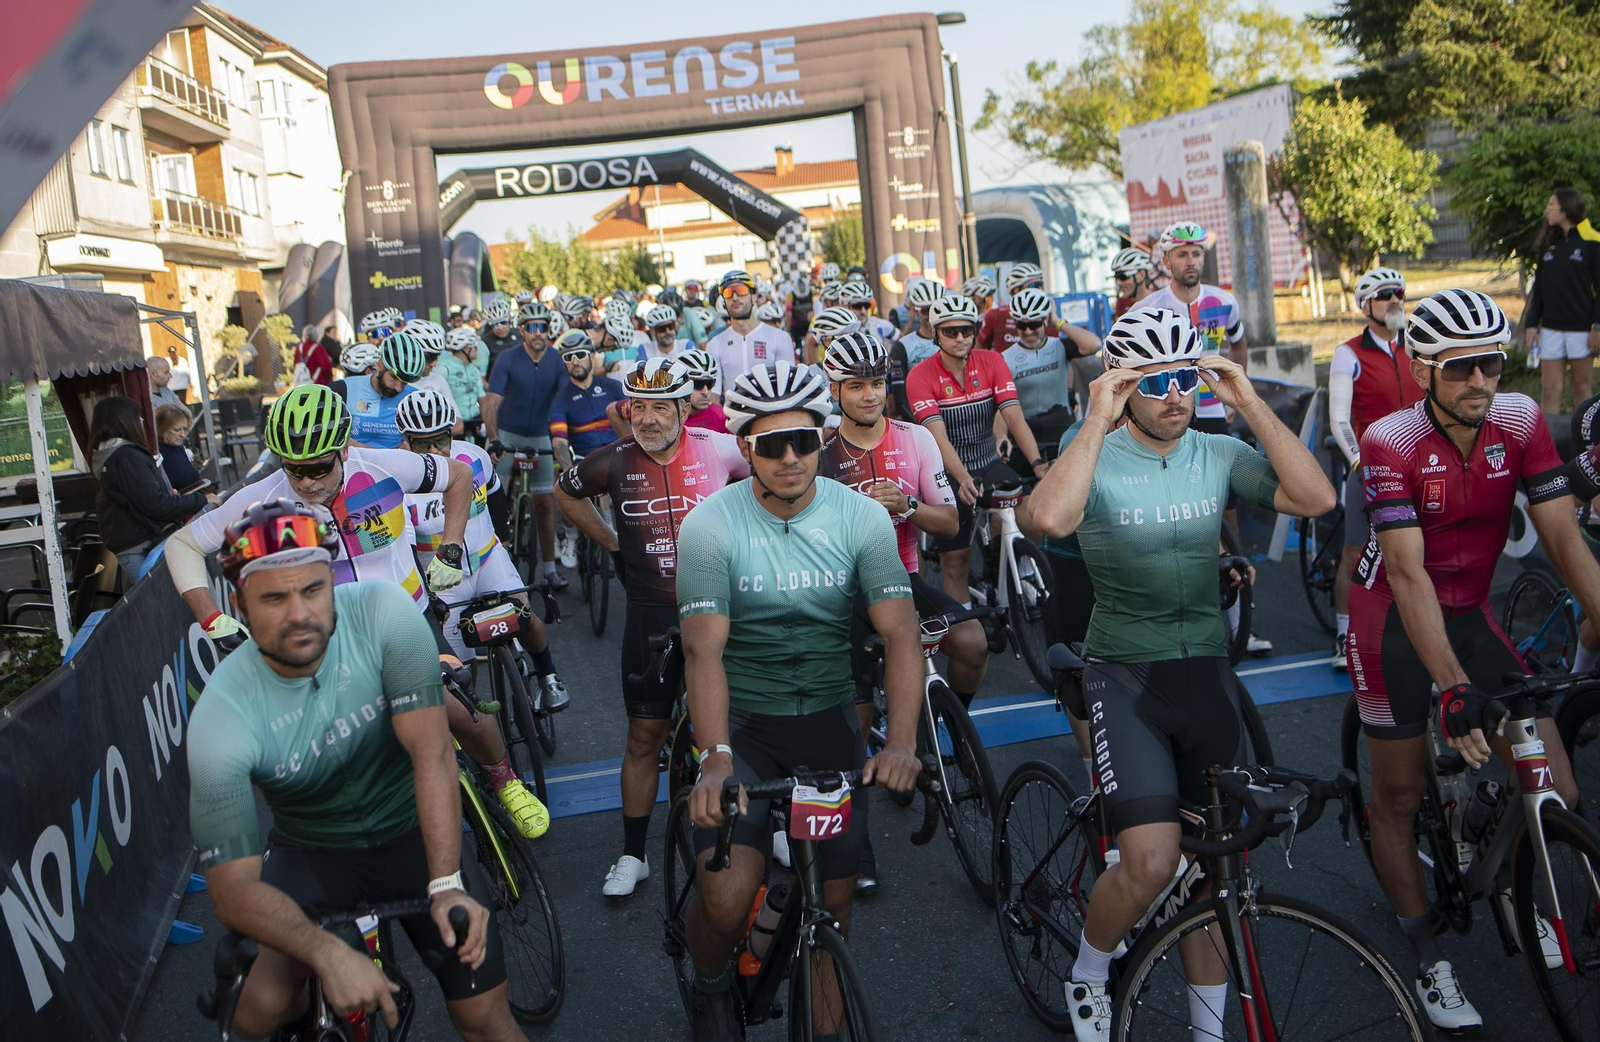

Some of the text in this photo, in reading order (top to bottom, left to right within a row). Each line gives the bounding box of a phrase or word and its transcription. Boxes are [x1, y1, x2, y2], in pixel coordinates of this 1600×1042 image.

[483, 36, 801, 110] OURENSE
[705, 88, 805, 116] TERMAL
[1184, 150, 1210, 165] SACRA
[495, 156, 659, 197] RODOSA
[1186, 164, 1219, 181] CYCLING
[689, 159, 782, 219] www.rodosa.com
[626, 473, 646, 481] GOBIK
[1122, 474, 1149, 485] GOBIK
[1421, 465, 1447, 474] VIATOR
[998, 498, 1018, 508] 126
[1120, 496, 1218, 526] CC LOBIOS
[738, 569, 847, 592] CC LOBIOS
[882, 586, 899, 594] KIKE
[690, 600, 716, 610] RAMOS
[489, 621, 509, 637] 28
[274, 695, 388, 779] CC LOBIOS
[1092, 701, 1118, 795] CC LOBIOS
[806, 813, 843, 836] 172
[1155, 861, 1206, 929] MMR
